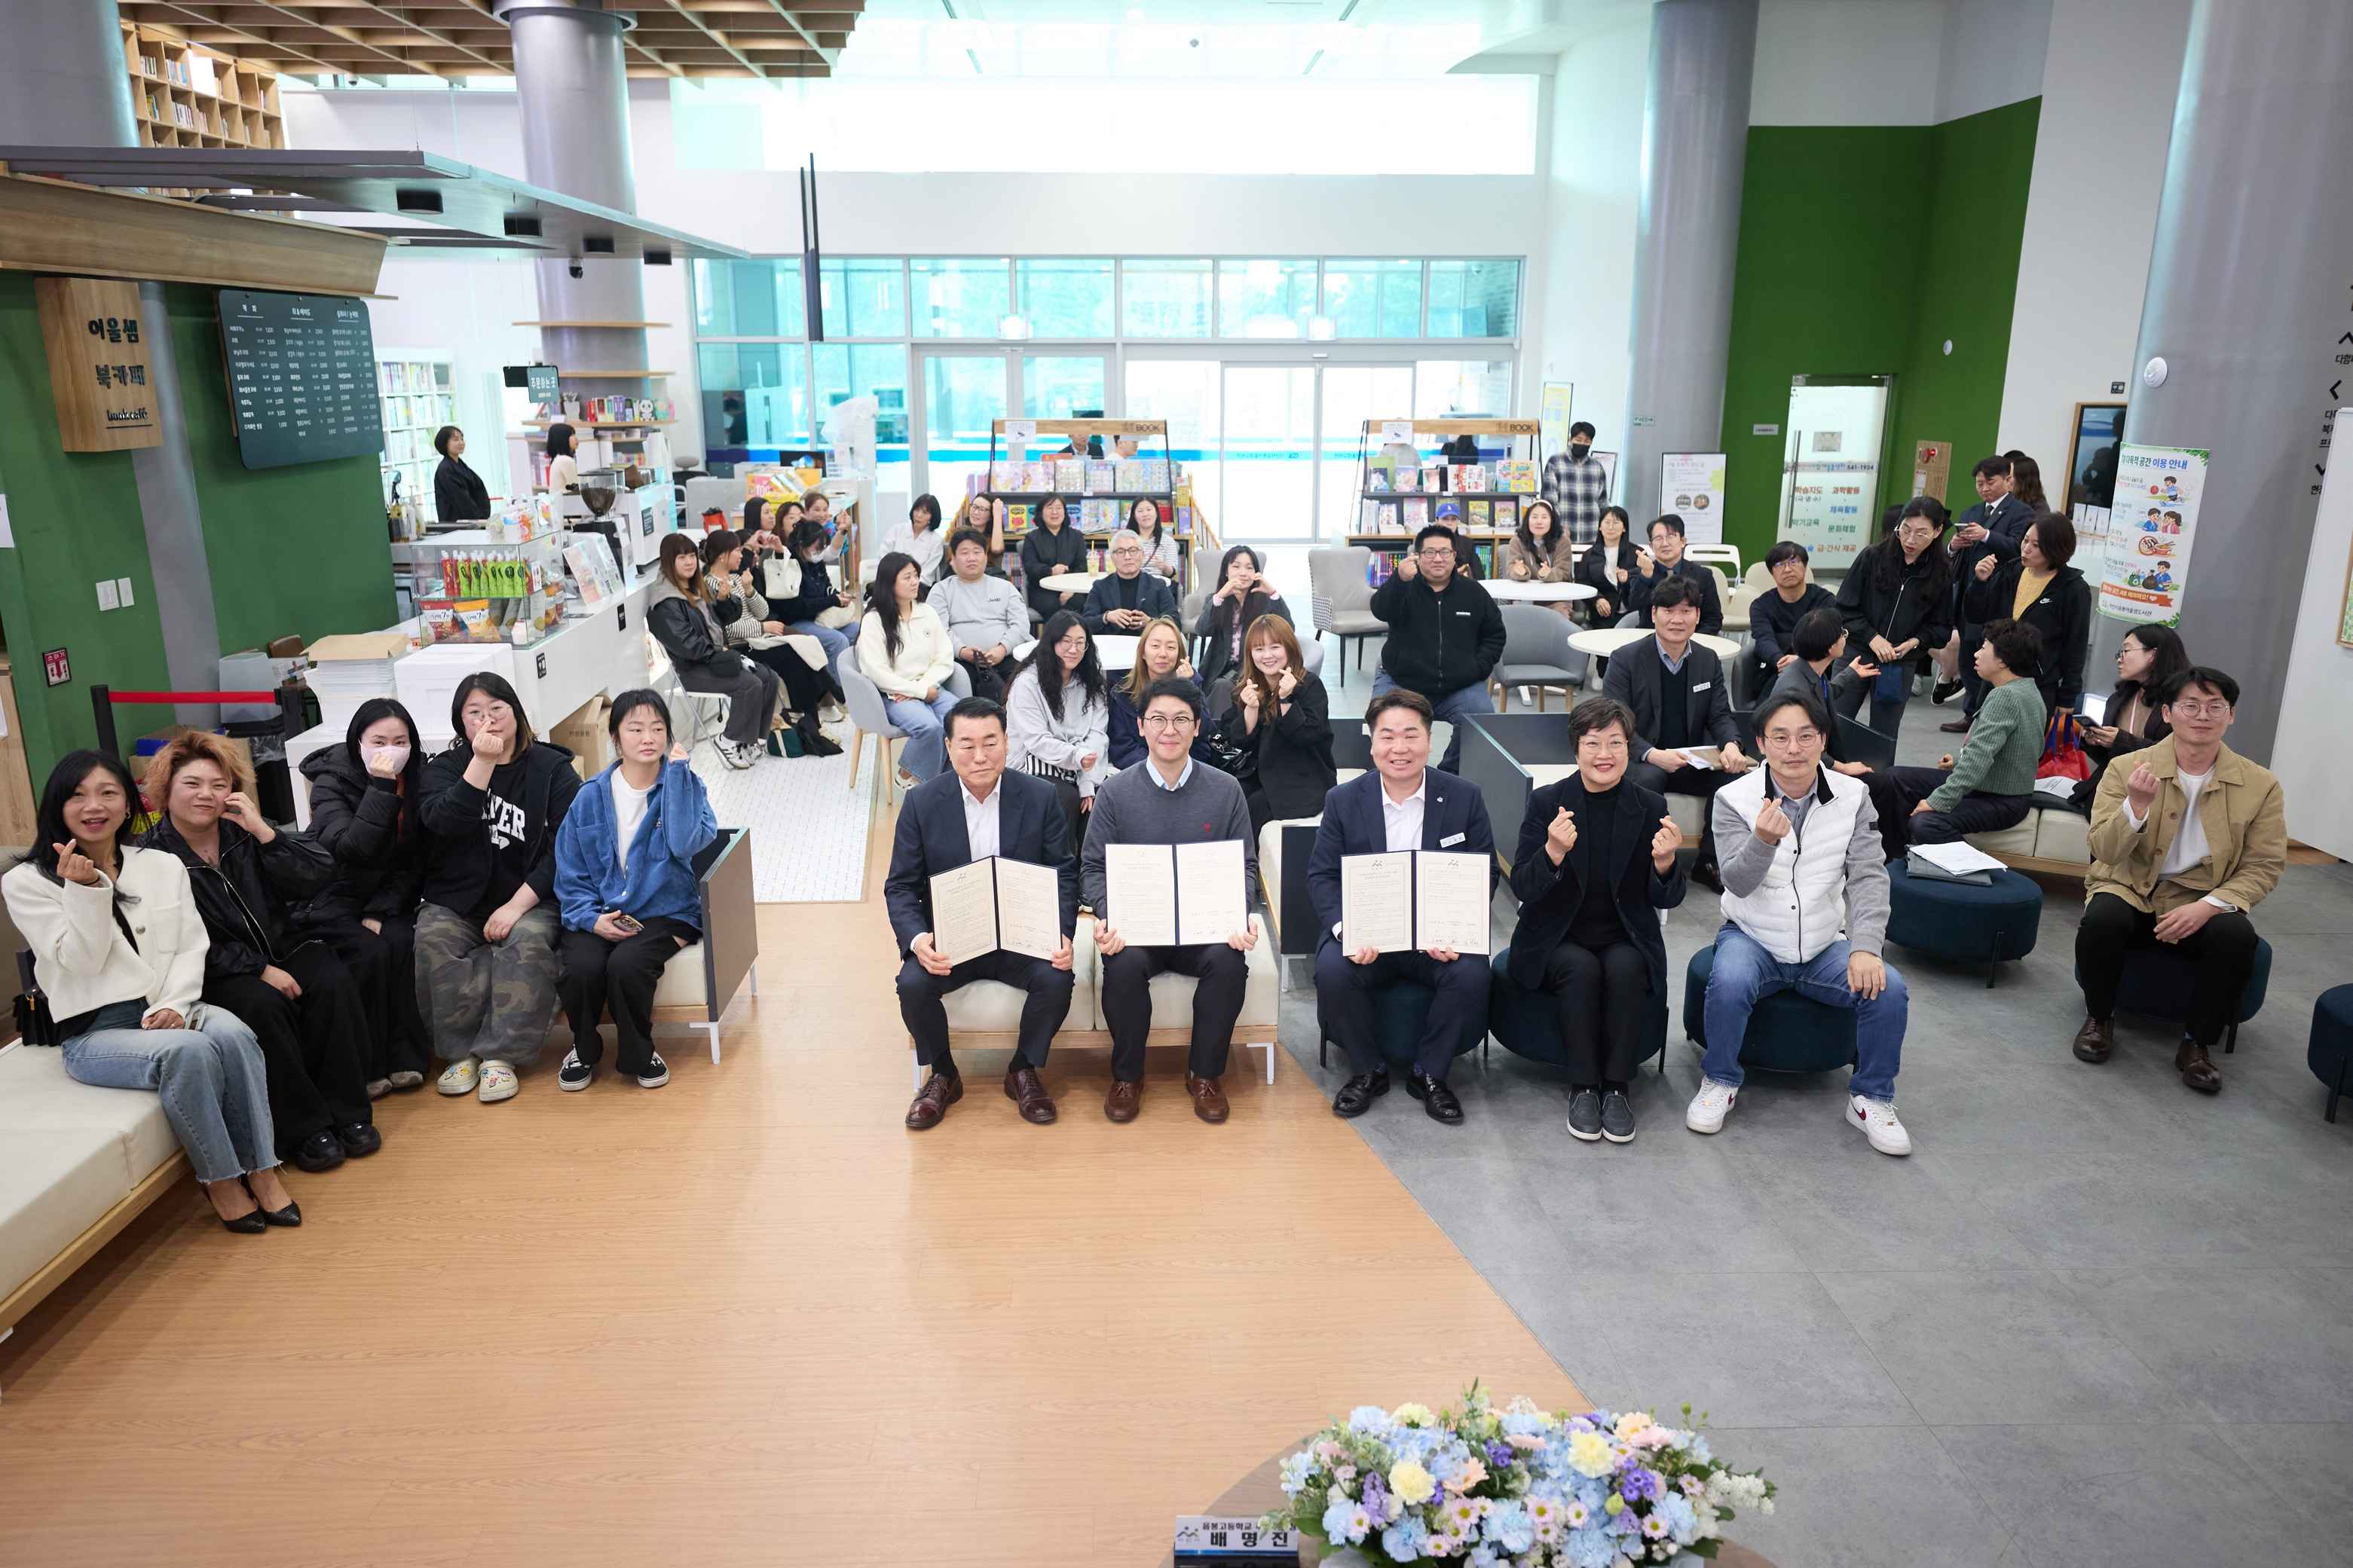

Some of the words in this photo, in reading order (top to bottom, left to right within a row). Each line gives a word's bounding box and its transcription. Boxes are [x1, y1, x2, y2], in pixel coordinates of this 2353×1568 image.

[88, 317, 139, 343] 어울샘
[96, 364, 145, 390] 북카페
[107, 409, 130, 421] book
[1136, 423, 1160, 432] BOOK
[1510, 423, 1533, 432] BOOK
[2139, 457, 2152, 467] 공간
[2152, 457, 2168, 469] 이용
[2168, 458, 2188, 470] 안내
